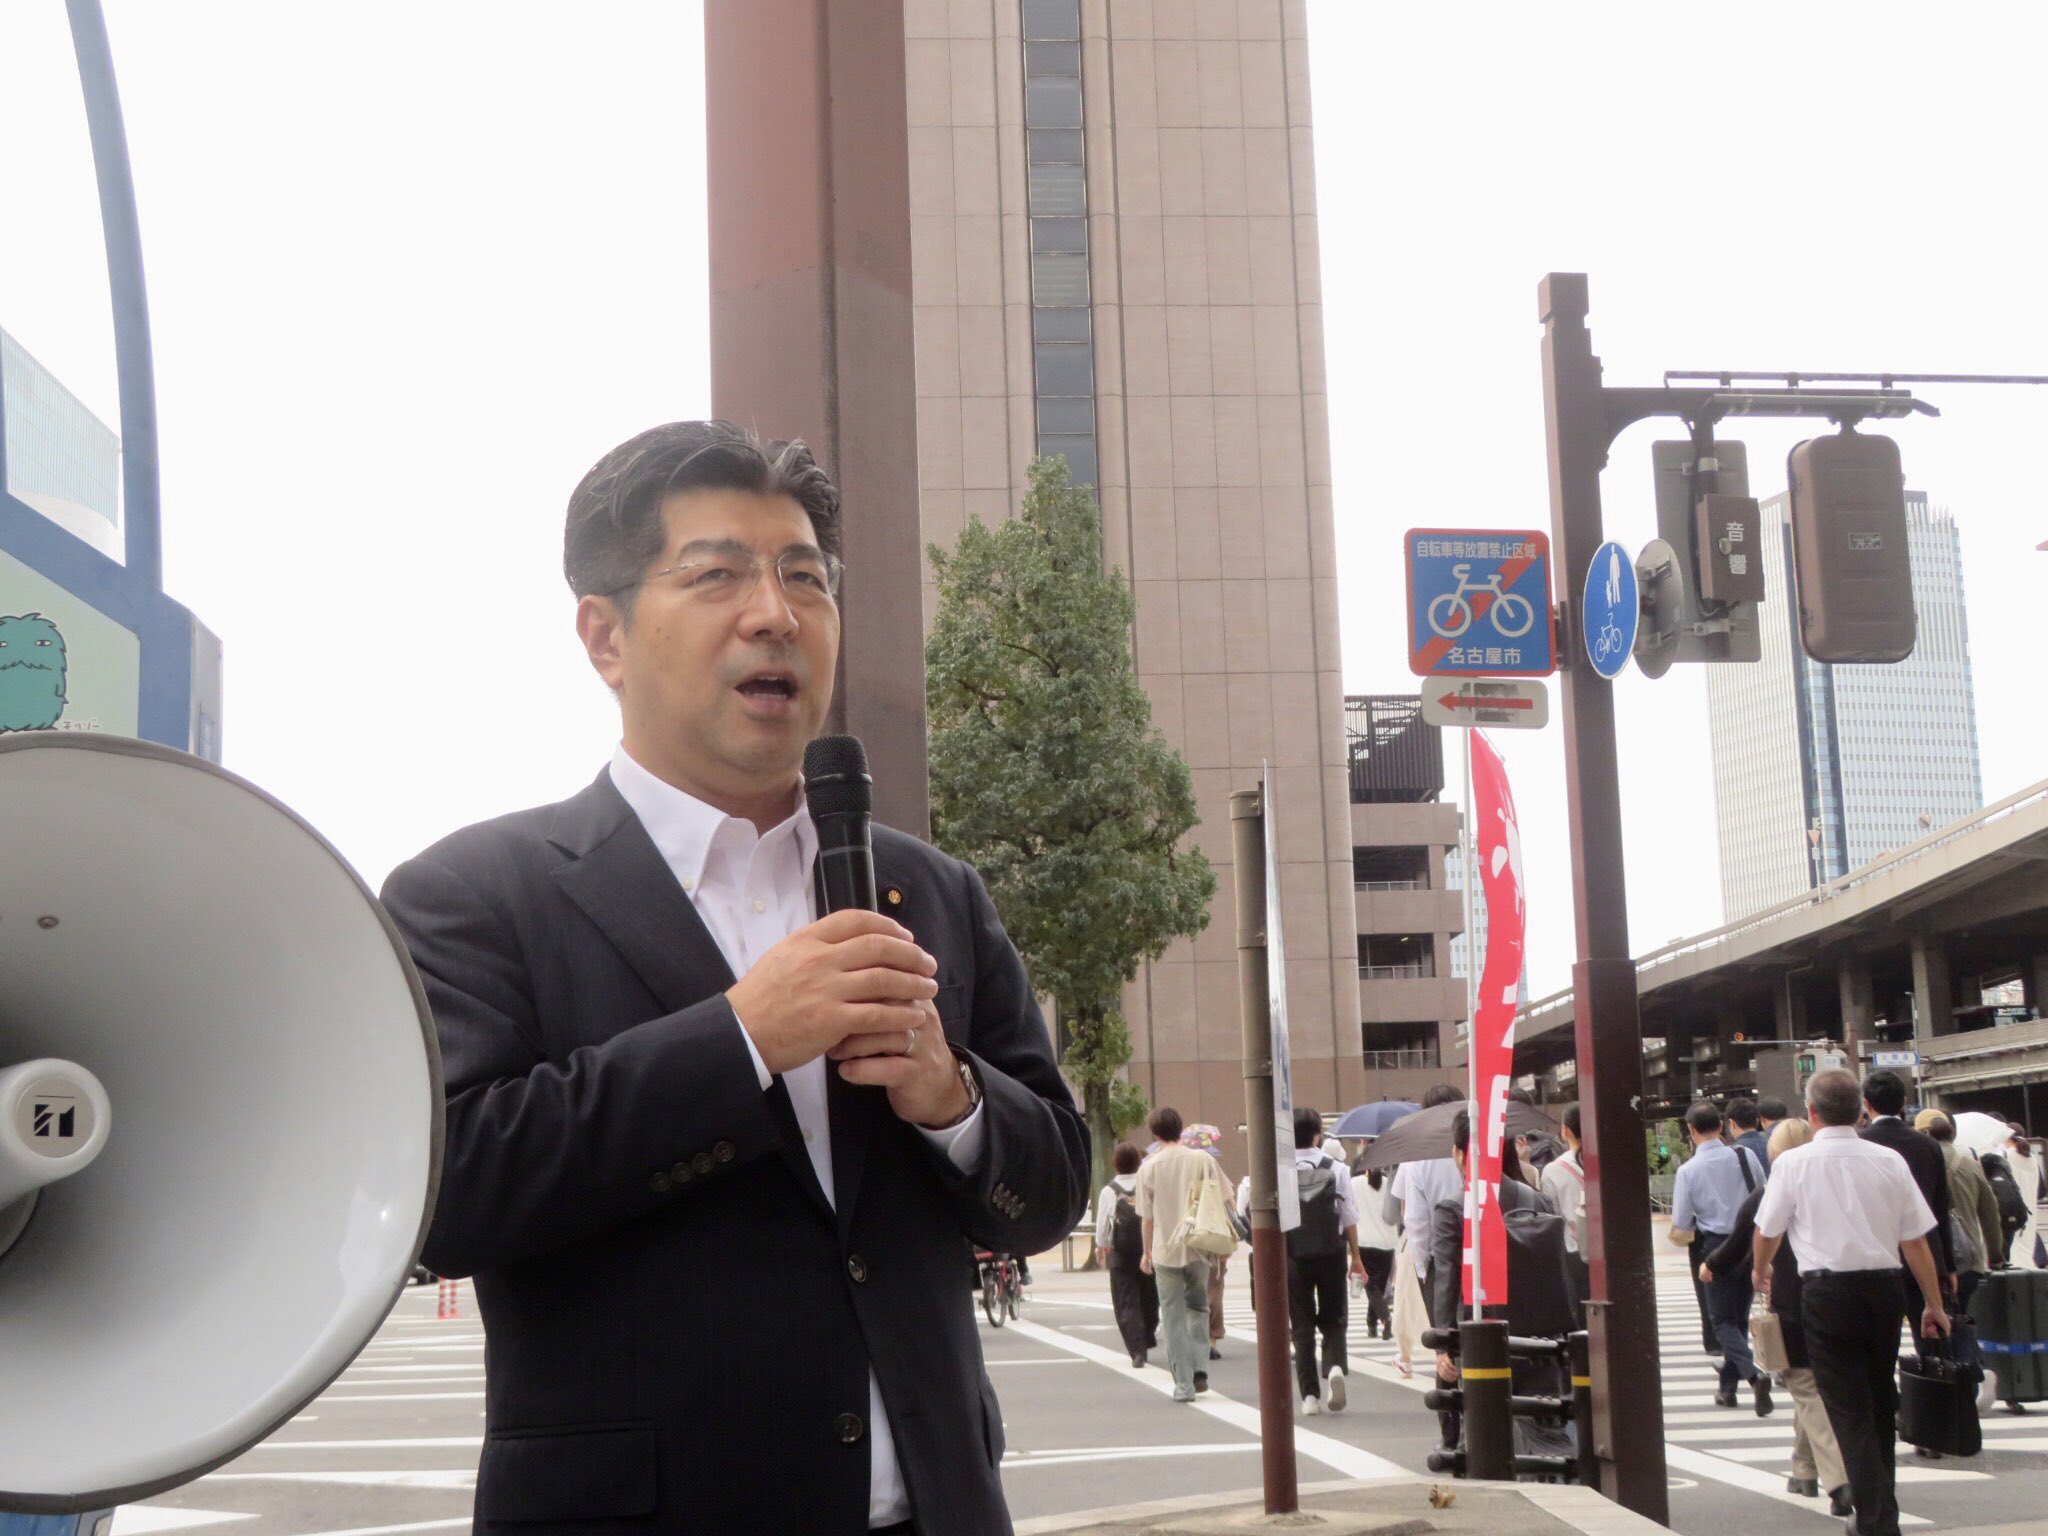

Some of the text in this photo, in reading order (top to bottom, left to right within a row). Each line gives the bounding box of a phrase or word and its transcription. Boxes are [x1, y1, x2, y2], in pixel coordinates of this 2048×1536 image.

[1416, 541, 1537, 559] 自転車等放置禁止区域
[1726, 521, 1747, 575] 音響
[1447, 647, 1521, 665] 名古屋市
